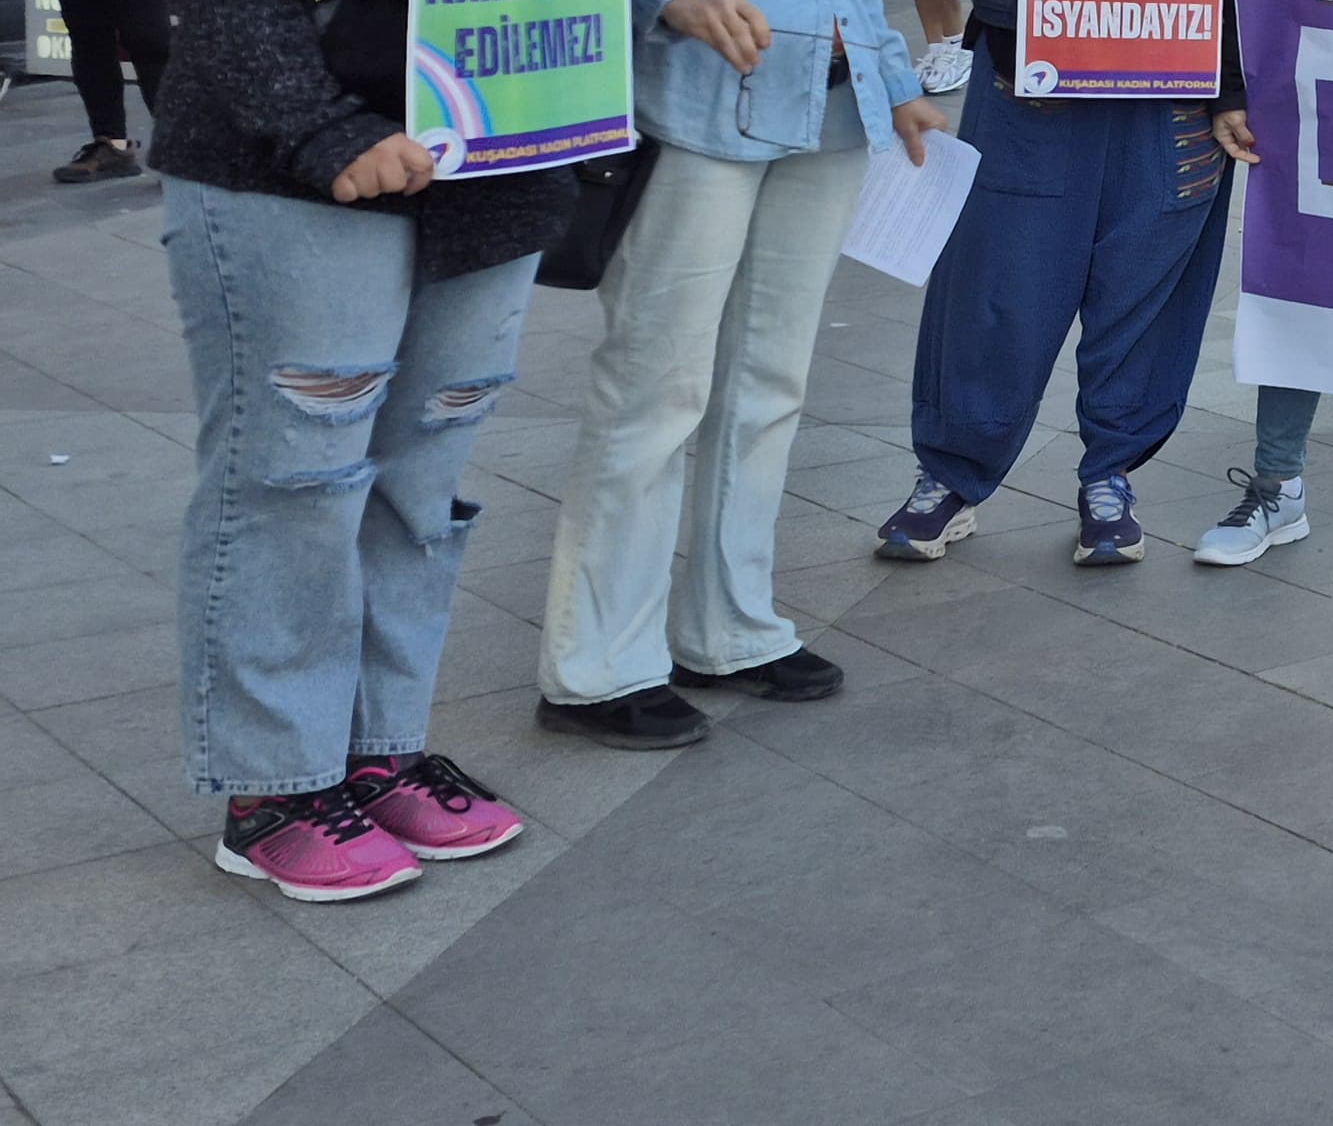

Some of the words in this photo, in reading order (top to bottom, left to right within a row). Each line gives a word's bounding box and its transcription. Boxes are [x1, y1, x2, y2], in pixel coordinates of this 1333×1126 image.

[453, 14, 605, 80] EDİLEMEZ!
[1058, 78, 1114, 91] KUŞADASI
[1116, 79, 1151, 90] KADIN
[1152, 79, 1217, 91] PLATFORMU
[465, 143, 538, 165] KUŞADASI
